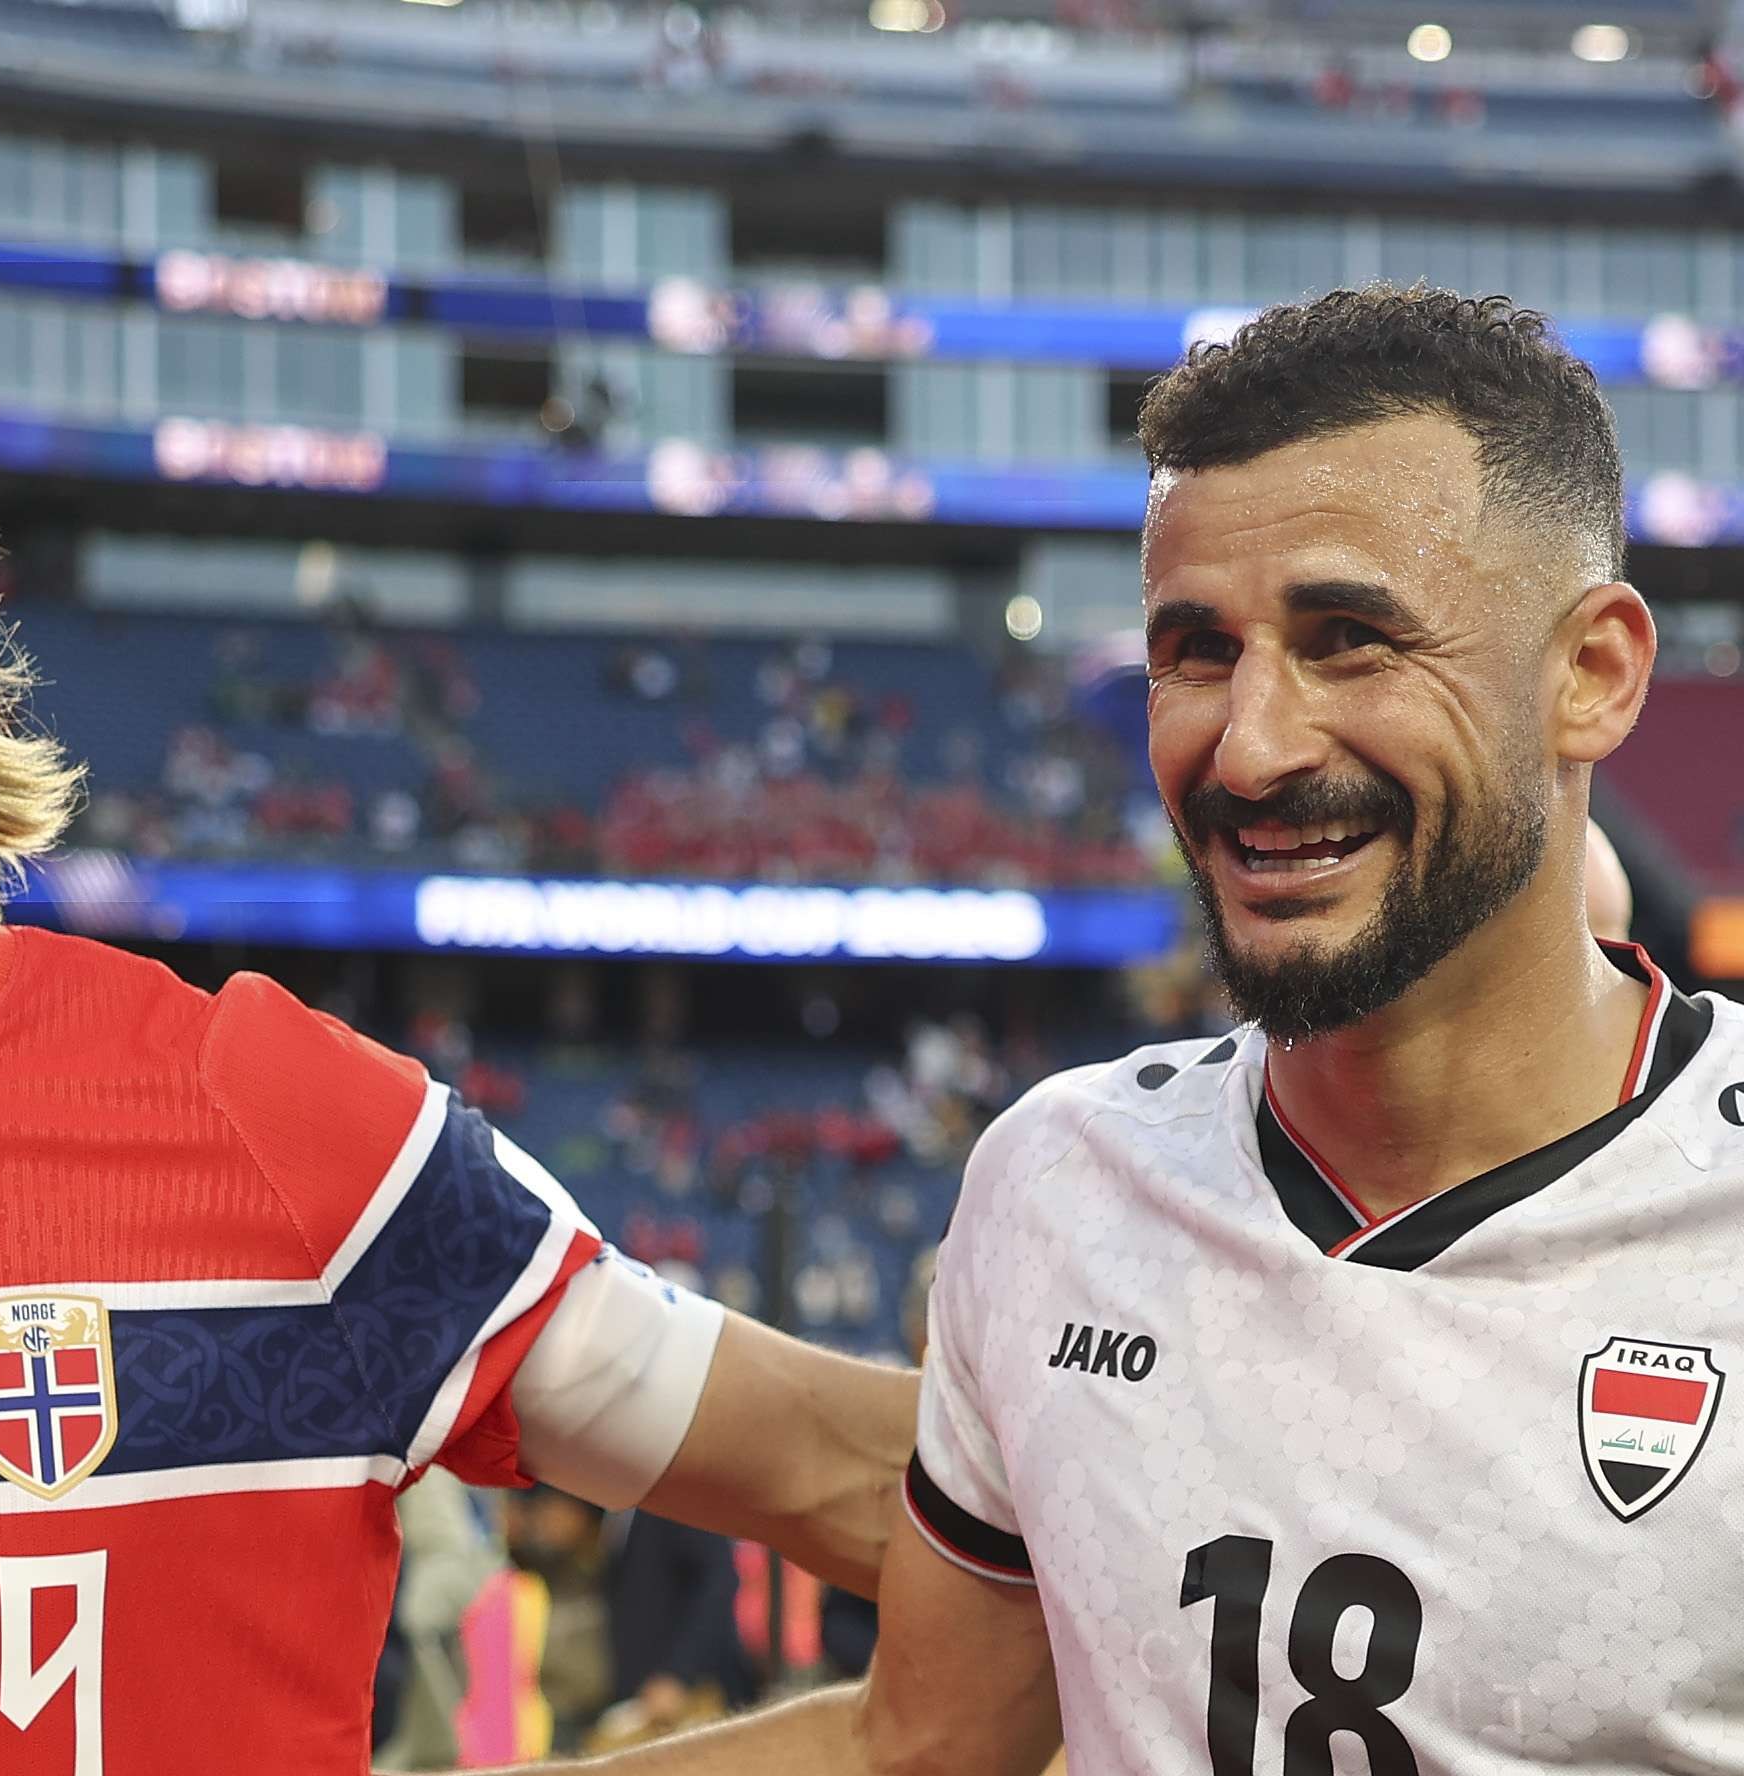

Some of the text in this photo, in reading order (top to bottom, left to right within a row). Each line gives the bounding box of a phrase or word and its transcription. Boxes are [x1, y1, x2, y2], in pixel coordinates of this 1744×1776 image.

[12, 1303, 56, 1322] NORGE
[1048, 1322, 1157, 1382] JAKO
[1617, 1348, 1695, 1373] IRAQ
